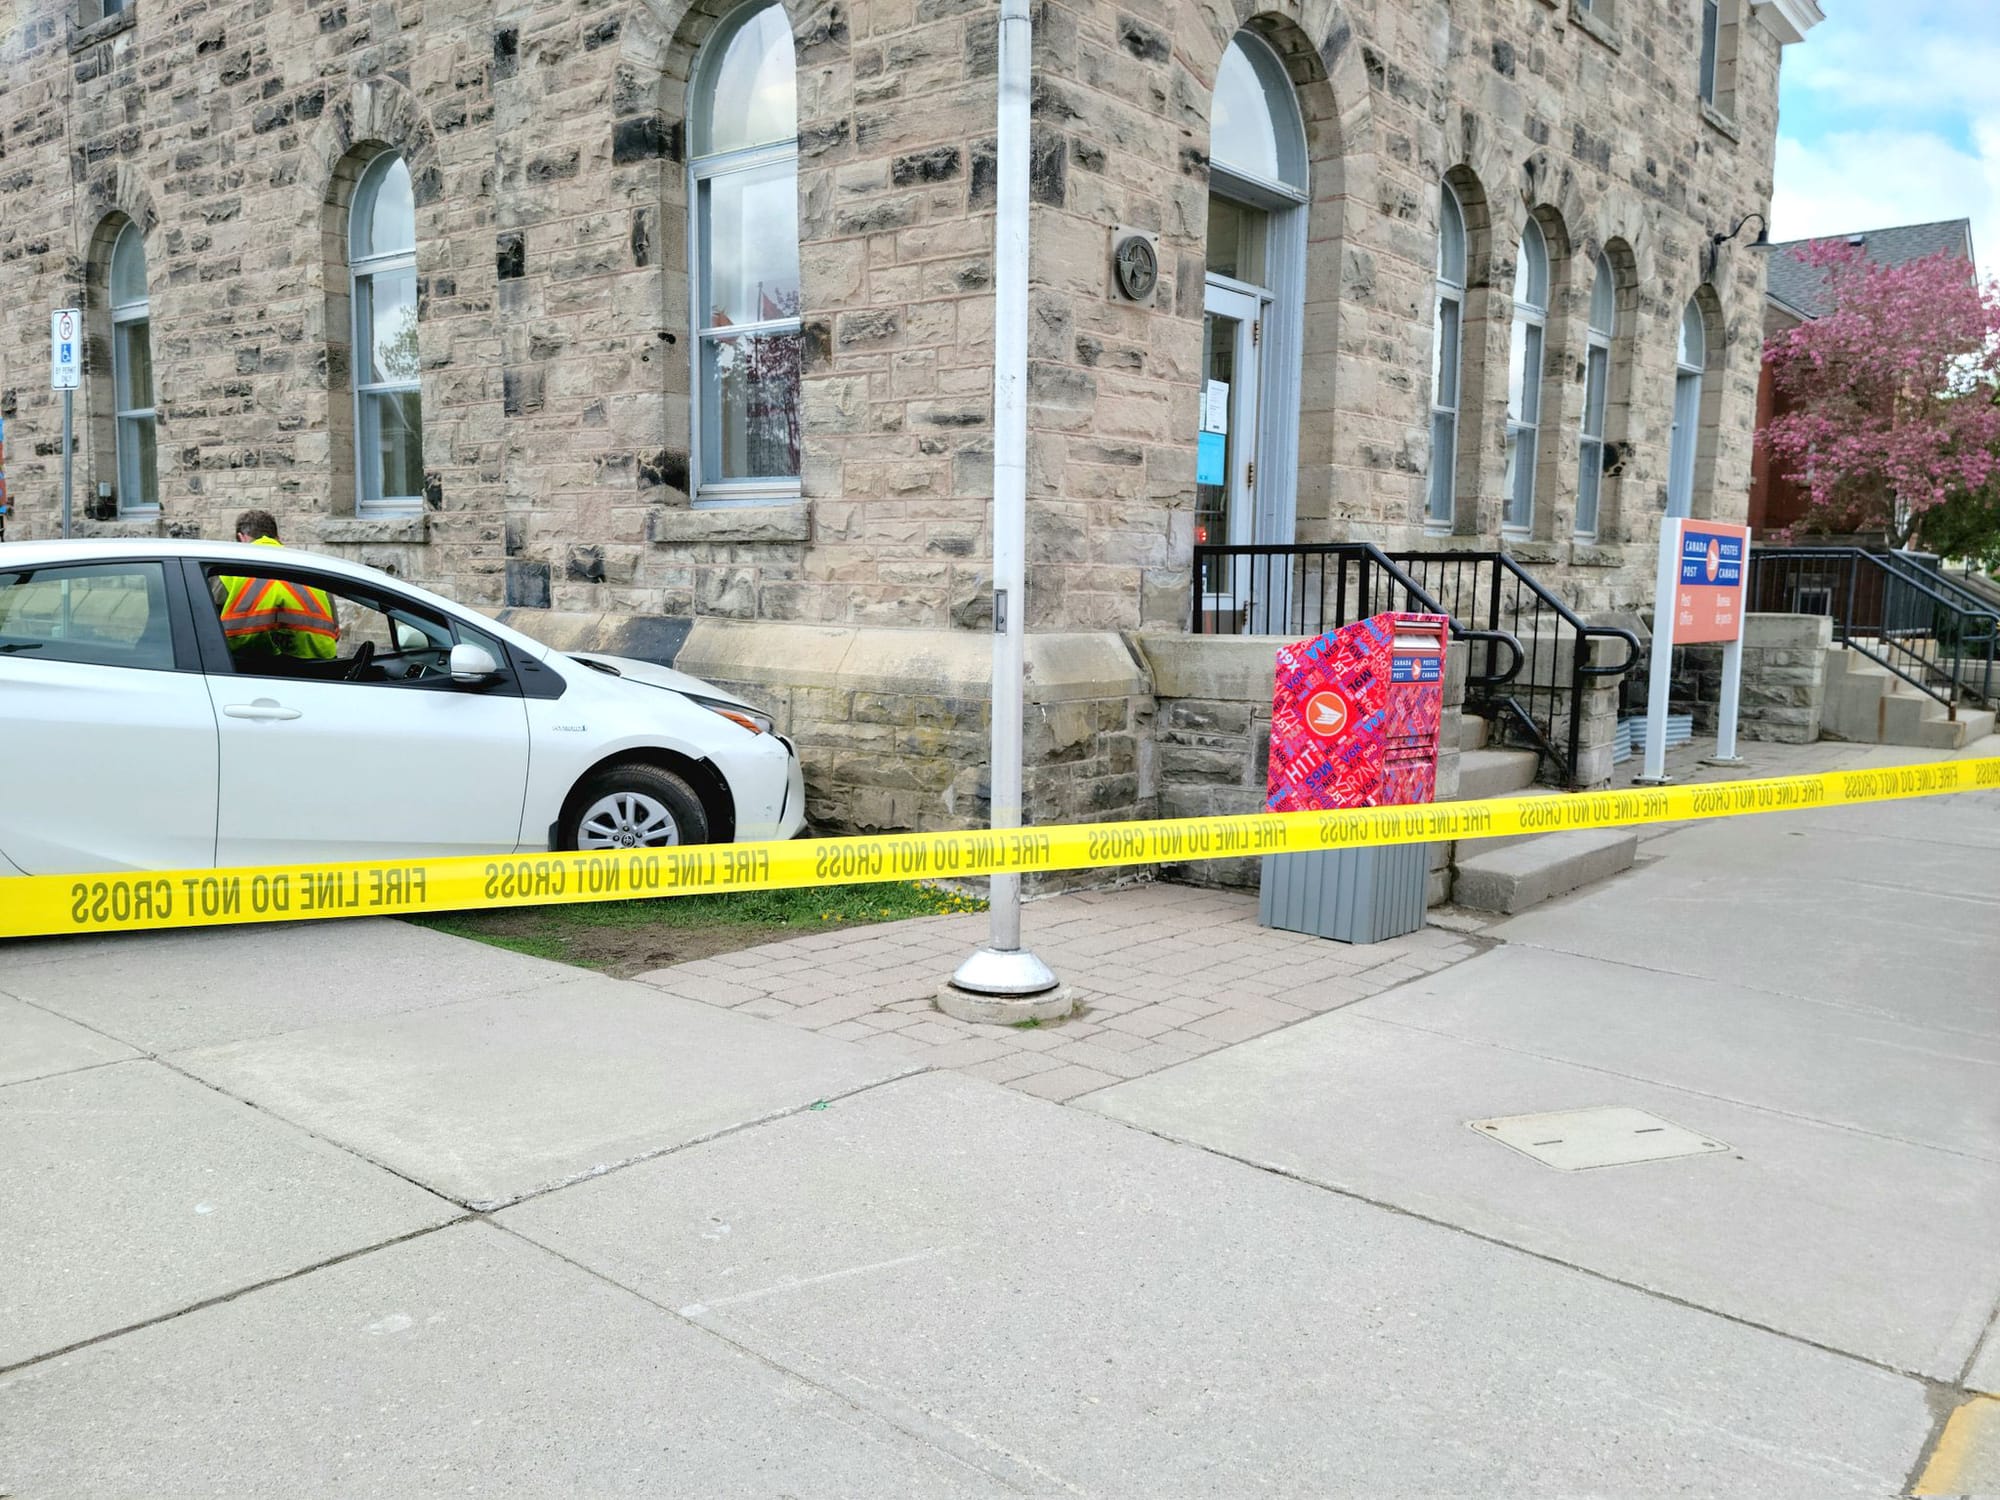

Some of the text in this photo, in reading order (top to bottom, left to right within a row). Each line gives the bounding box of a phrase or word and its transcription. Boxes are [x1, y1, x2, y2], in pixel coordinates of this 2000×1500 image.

[1685, 541, 1707, 552] CANADA
[1720, 544, 1738, 556] POSTES
[1683, 566, 1697, 577] POST
[1719, 568, 1738, 578] CANADA
[1341, 741, 1362, 765] V6K
[1285, 748, 1317, 786] H1T
[1347, 758, 1375, 791] R7N
